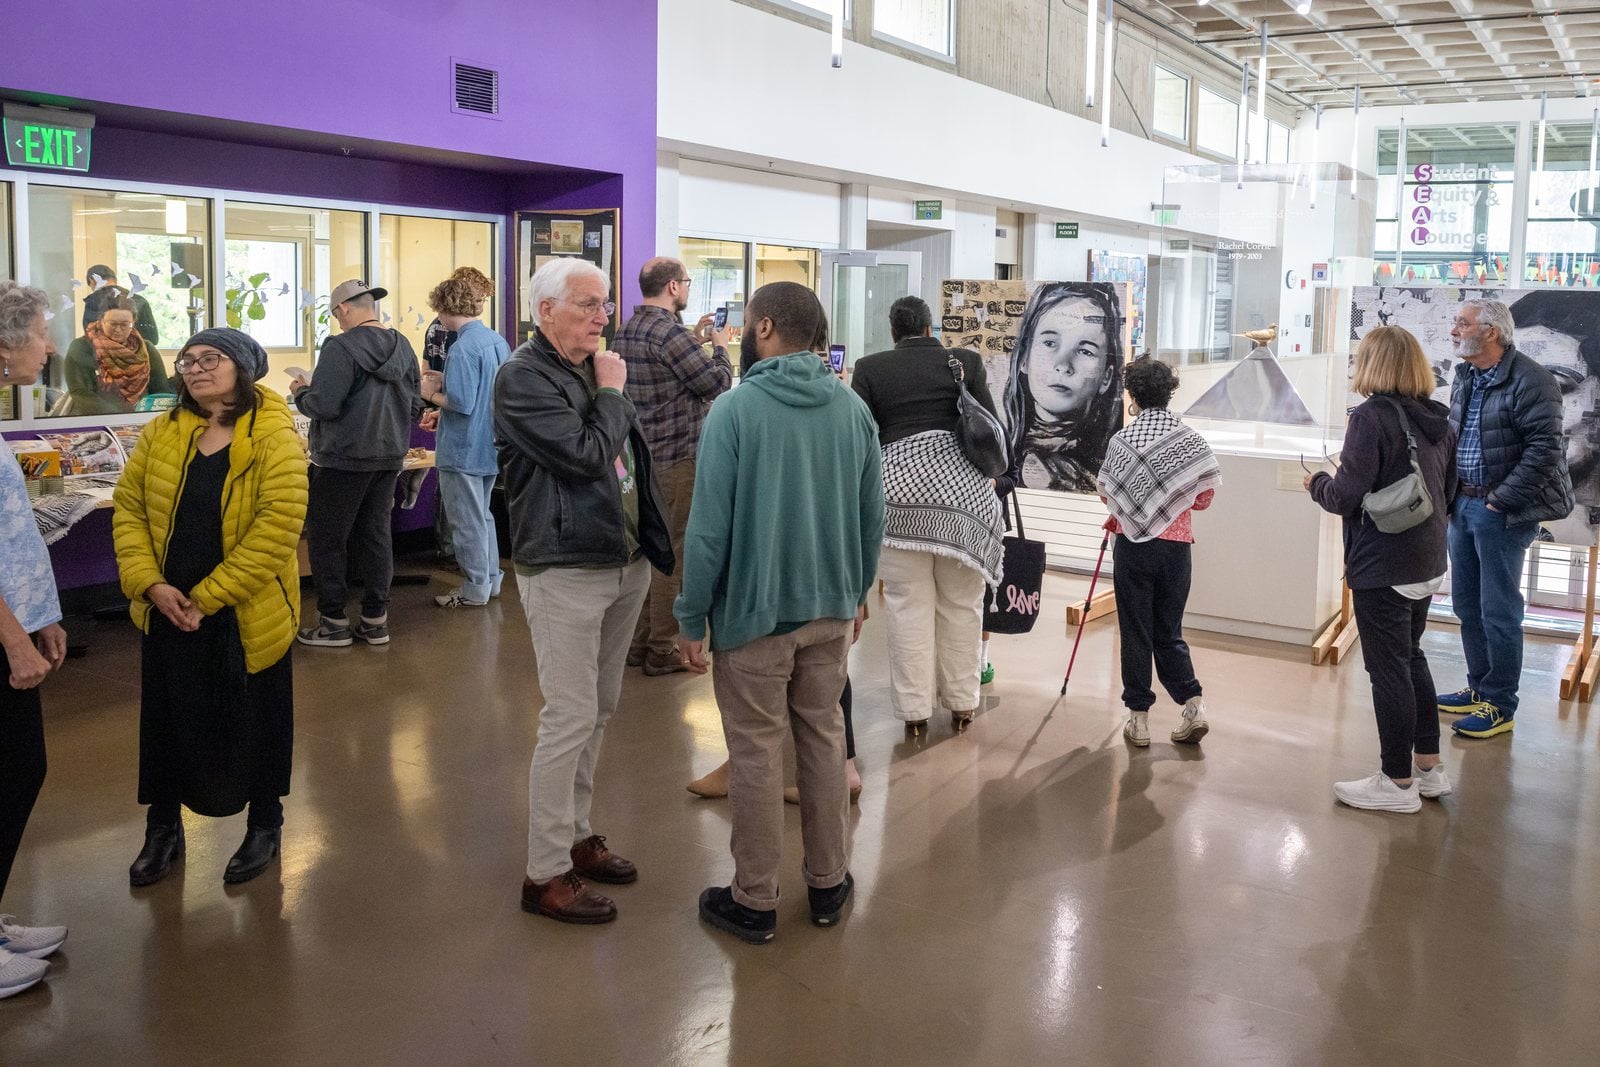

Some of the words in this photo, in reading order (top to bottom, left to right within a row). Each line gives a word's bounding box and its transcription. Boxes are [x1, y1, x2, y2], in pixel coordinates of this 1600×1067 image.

[24, 125, 77, 167] EXIT
[1418, 163, 1498, 180] Student
[1416, 185, 1482, 206] Equity
[1486, 190, 1500, 206] &
[1414, 207, 1457, 224] Arts
[1218, 241, 1244, 250] Rachel
[1246, 242, 1271, 250] Corrie
[1414, 228, 1488, 248] Lounge
[1006, 584, 1039, 615] love
